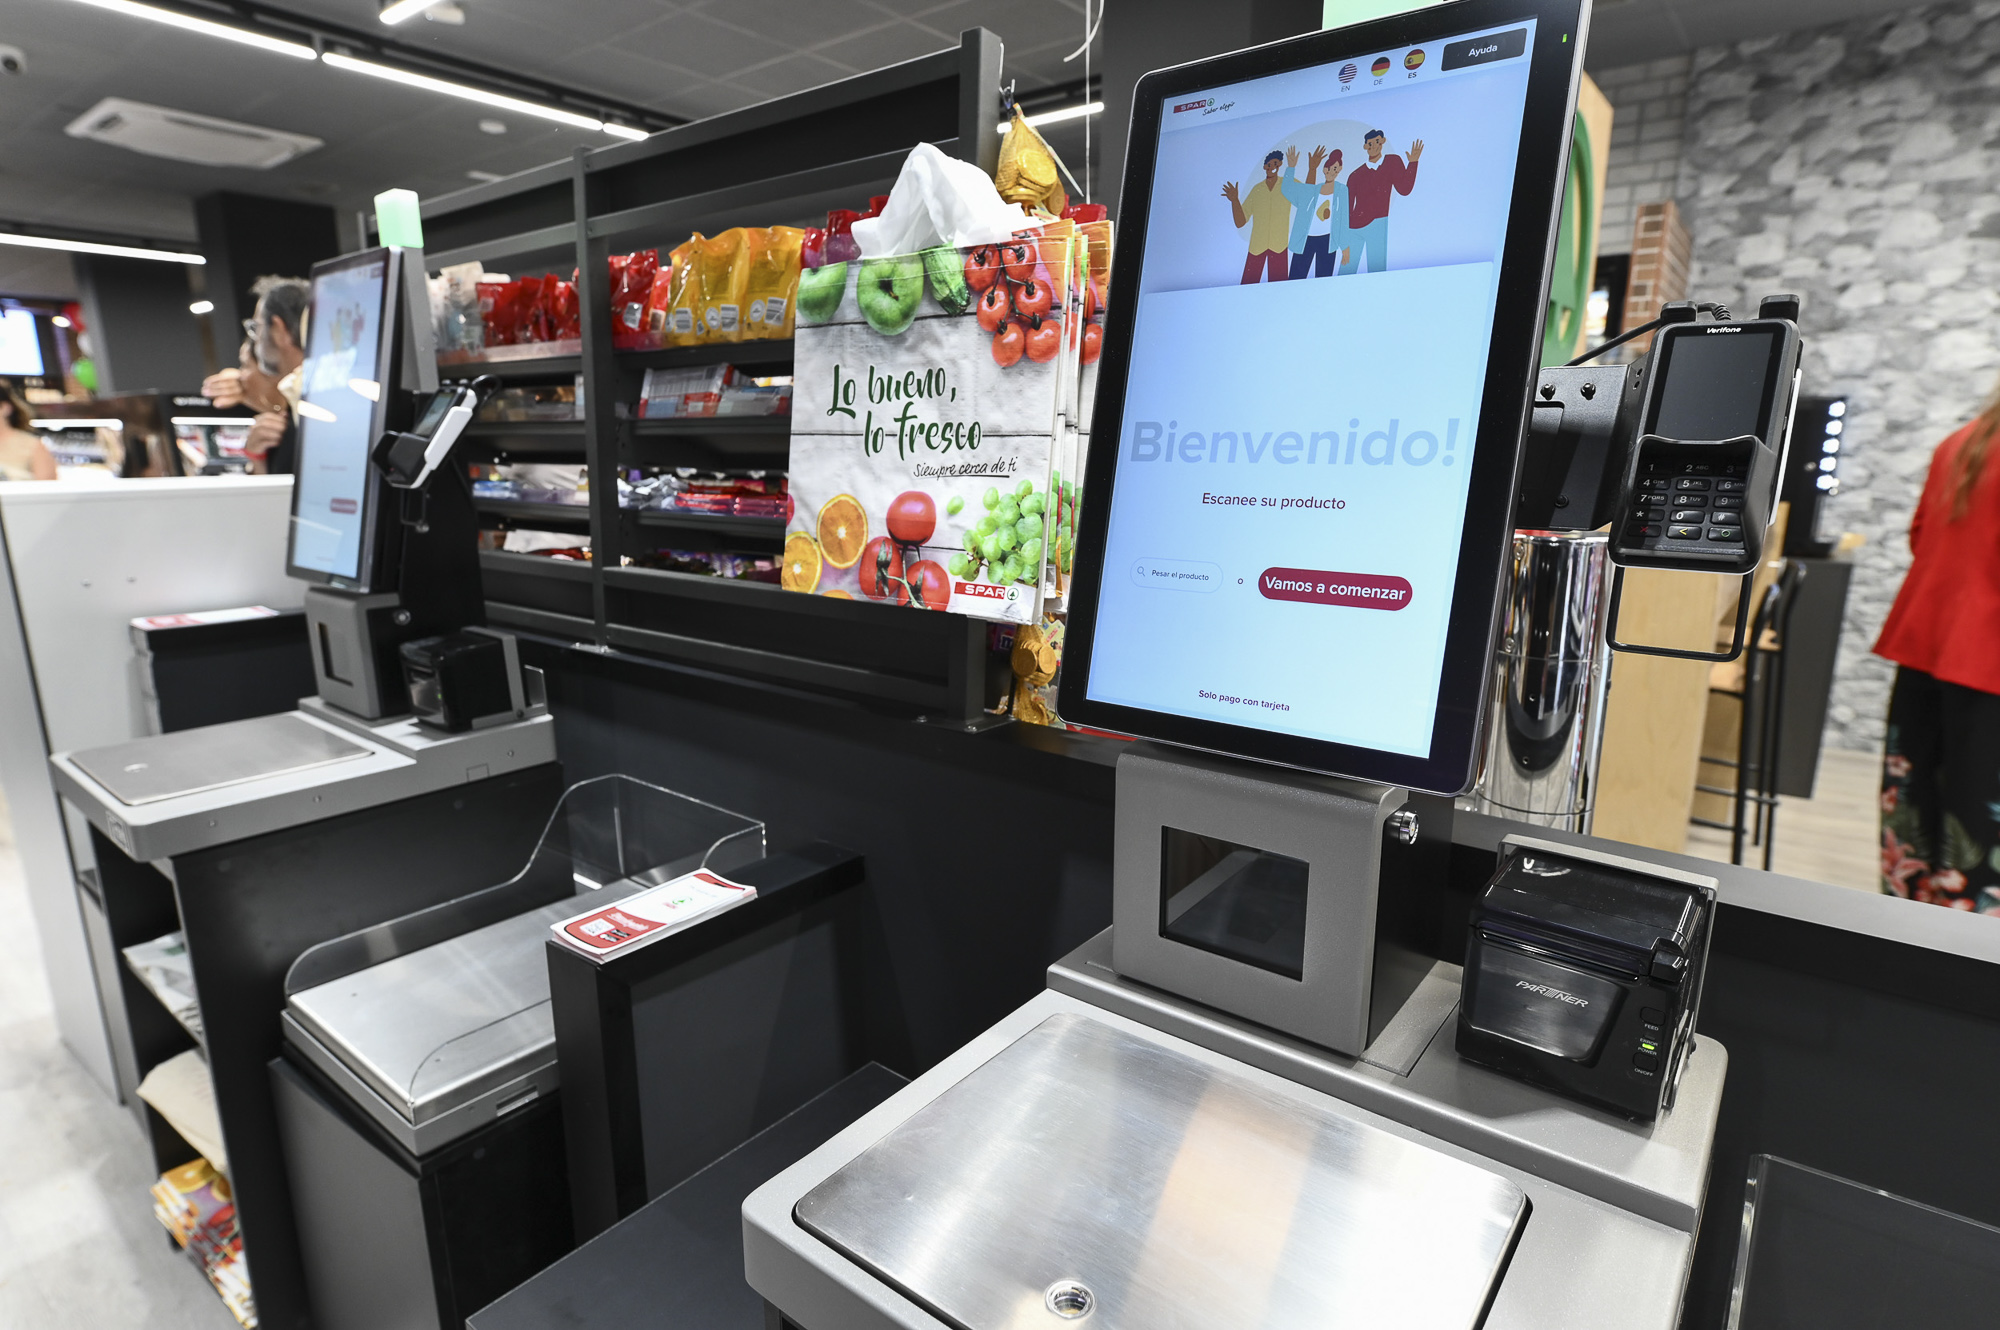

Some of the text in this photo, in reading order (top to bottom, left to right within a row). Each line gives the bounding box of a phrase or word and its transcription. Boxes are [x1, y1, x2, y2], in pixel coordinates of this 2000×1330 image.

[1468, 44, 1498, 57] Ayuda
[1180, 101, 1206, 111] SPAR
[826, 364, 957, 419] Lo bueno,
[864, 401, 982, 461] lo fresco
[1130, 418, 1460, 467] Bienvenido!
[958, 463, 988, 475] cerca
[991, 456, 1006, 473] de
[1007, 456, 1018, 472] ti
[1685, 464, 1693, 472] 2
[1726, 465, 1734, 473] 3
[1724, 481, 1732, 489] 6
[1202, 492, 1346, 510] Escanee su producto
[1640, 494, 1648, 502] 7
[1721, 497, 1729, 505] 9
[1675, 512, 1684, 520] 0
[1151, 569, 1170, 577] Pesar
[1178, 572, 1209, 581] producto
[965, 584, 1005, 598] SPAR
[1265, 576, 1406, 601] Vamos a comenzar
[1198, 689, 1290, 711] Solo pago con tarjeta
[1516, 980, 1589, 1008] PARTNER
[1644, 1023, 1659, 1031] FEED
[1640, 1038, 1658, 1047] ERROR
[1638, 1047, 1657, 1055] POWER
